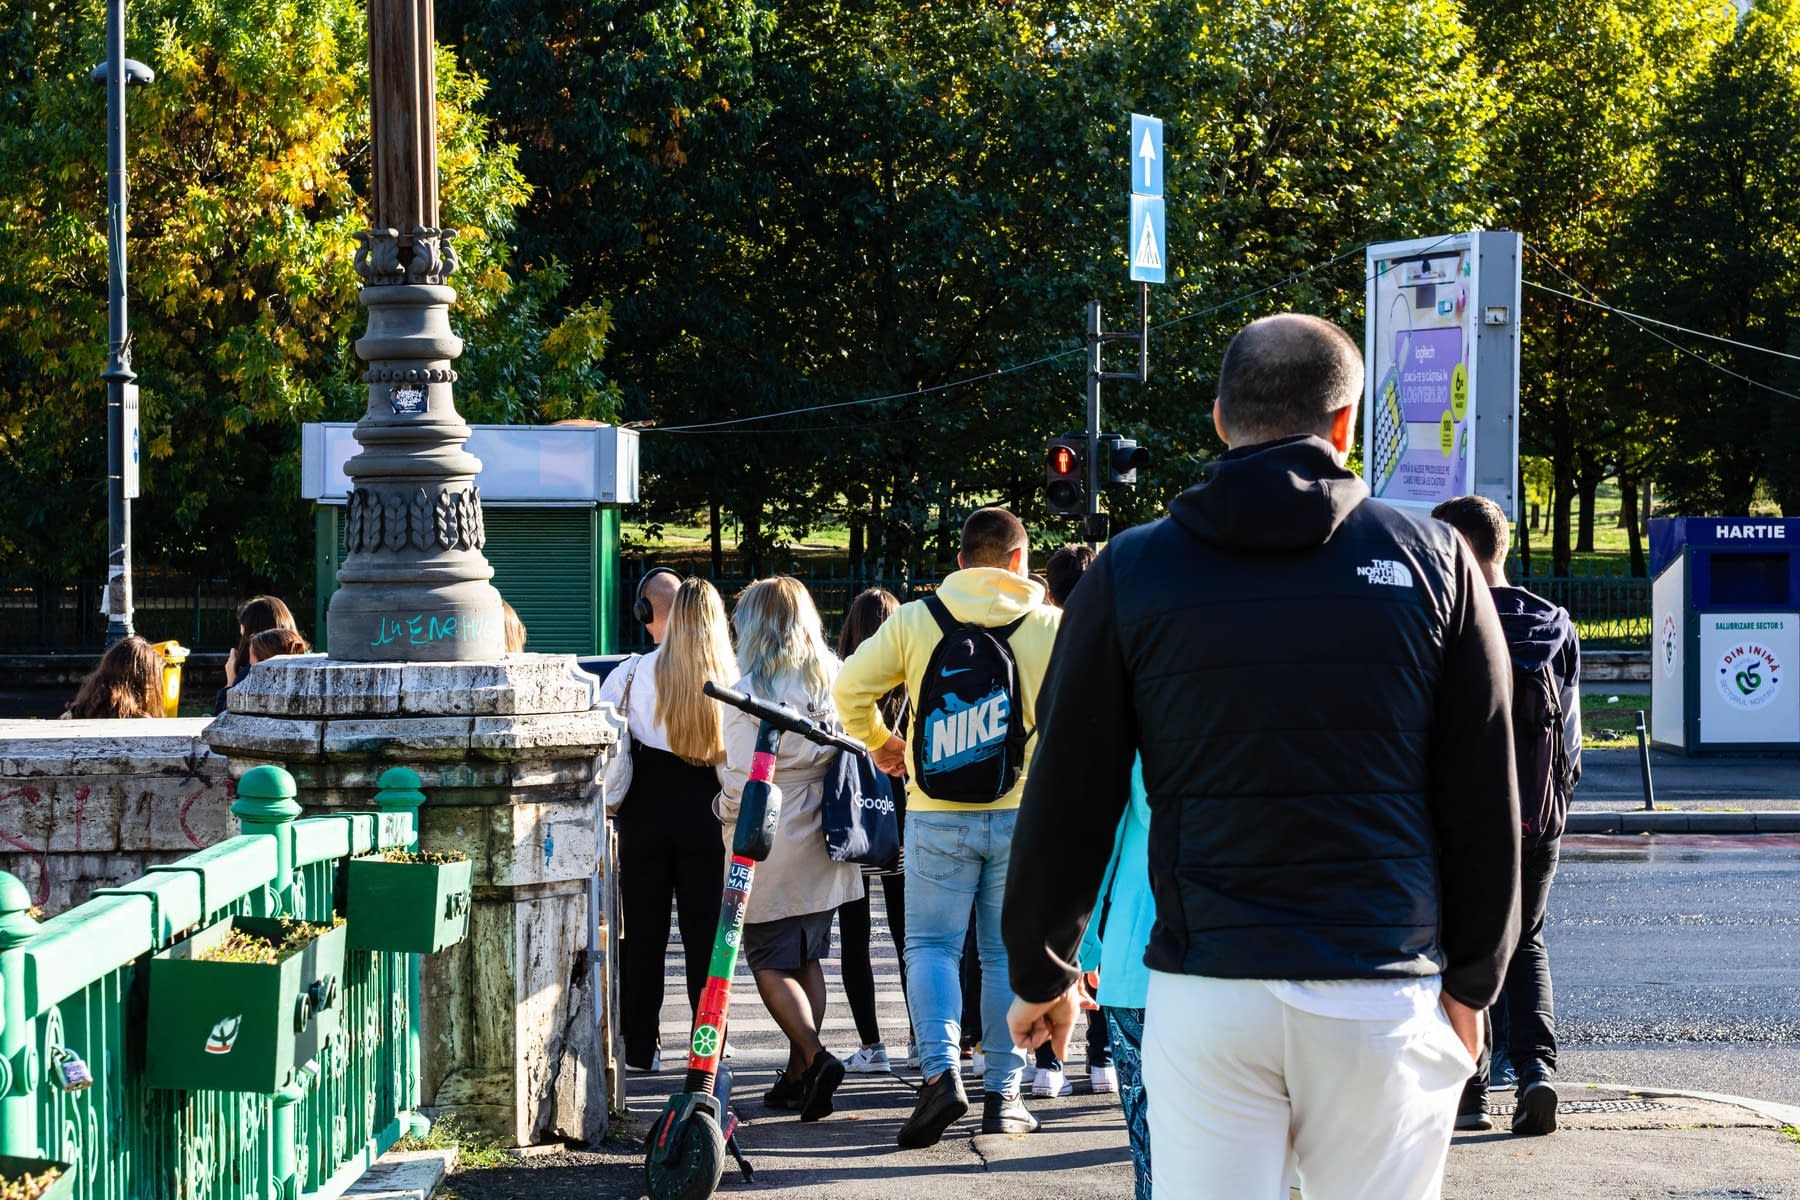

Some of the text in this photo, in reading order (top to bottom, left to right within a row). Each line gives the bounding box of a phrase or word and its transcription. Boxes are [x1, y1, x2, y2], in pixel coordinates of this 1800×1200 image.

[1715, 525, 1785, 539] HARTIE
[1371, 559, 1393, 568] THE
[1356, 566, 1394, 577] NORTH
[1368, 575, 1395, 585] FACE
[1715, 622, 1784, 631] SALUBRIZARE SECTOR 5
[1724, 645, 1781, 673] DIN INIMĂ
[931, 694, 1010, 764] NIKE
[854, 792, 895, 816] Google
[732, 902, 745, 928] Lime
